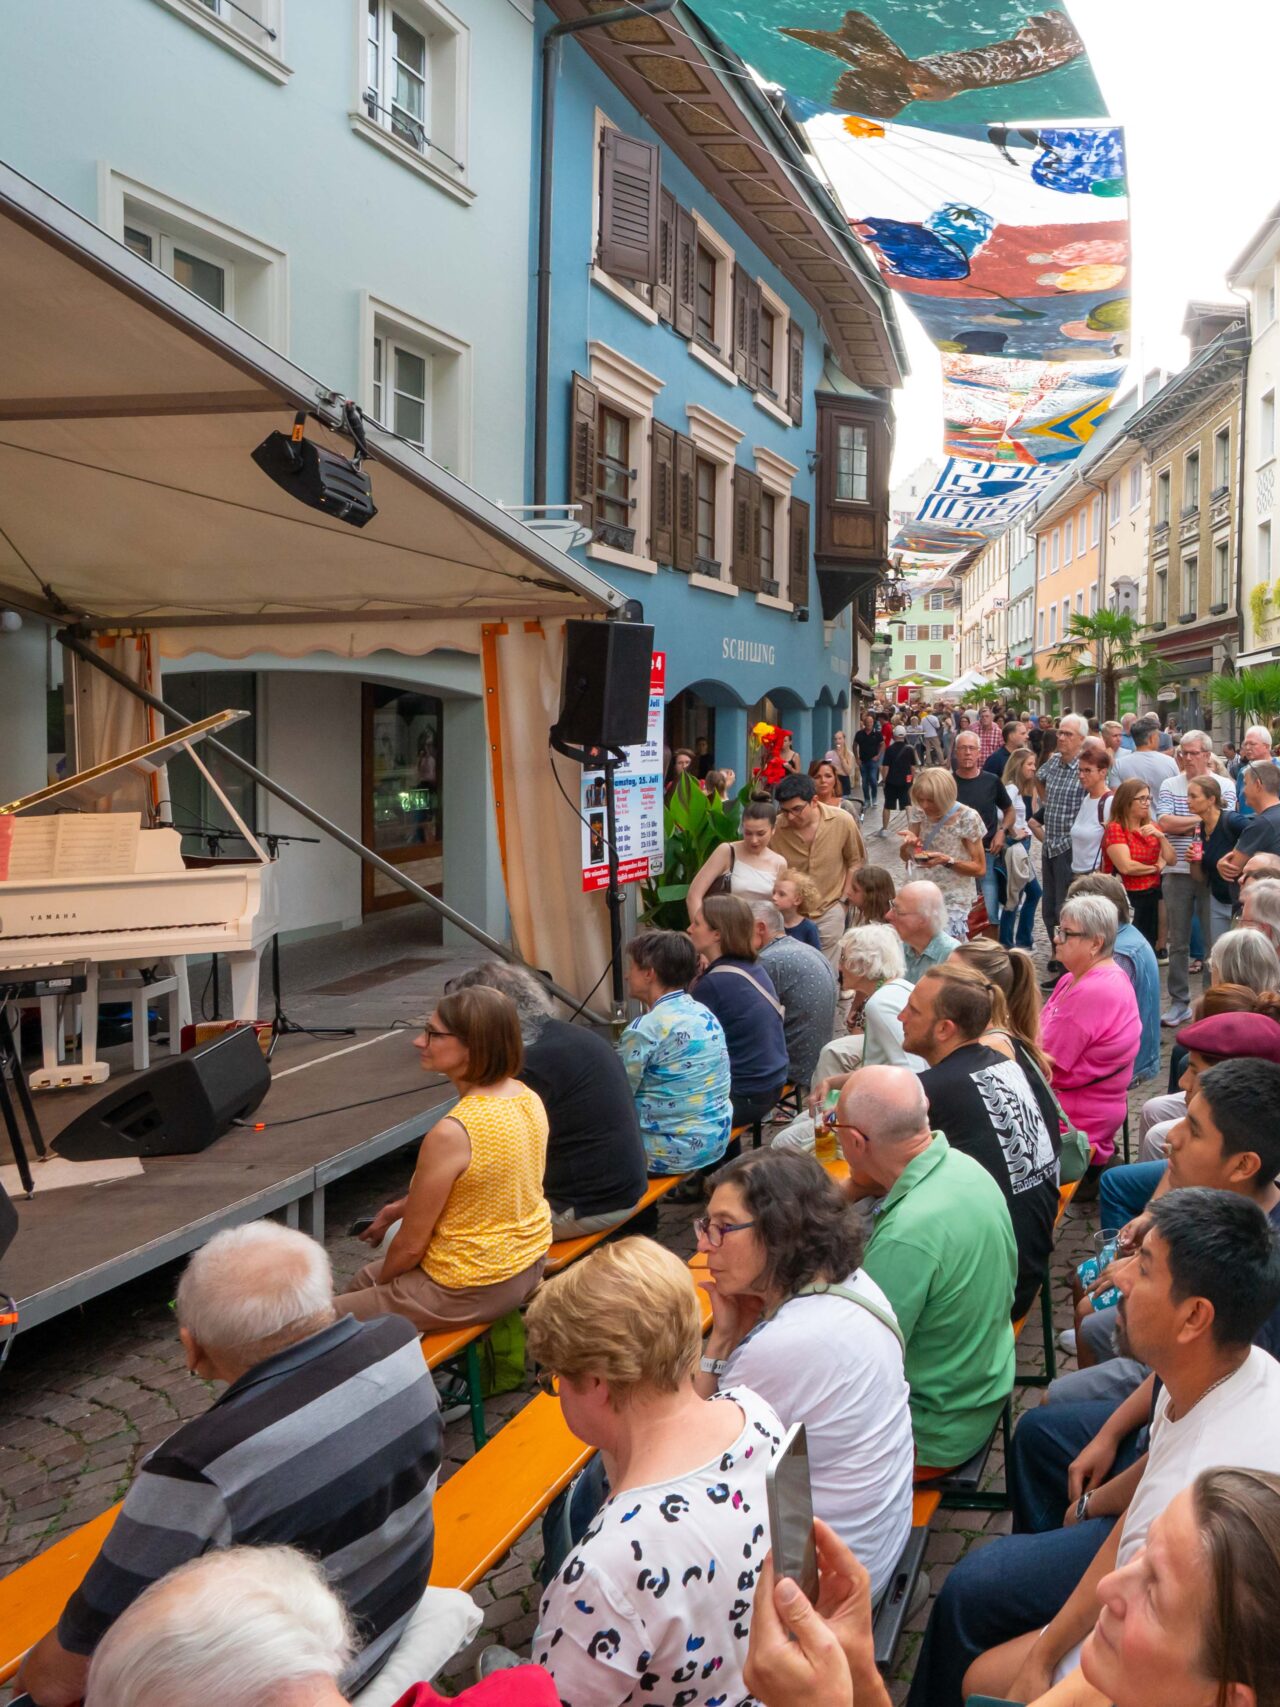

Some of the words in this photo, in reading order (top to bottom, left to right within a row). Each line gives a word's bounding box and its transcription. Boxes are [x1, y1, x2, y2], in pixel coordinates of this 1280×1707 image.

[722, 637, 776, 666] SCHILLING
[614, 778, 637, 787] amstag,
[639, 776, 648, 785] 25.
[649, 774, 659, 784] Juli
[30, 912, 77, 922] YAMAHA
[969, 1067, 1034, 1185] VOLCOM
